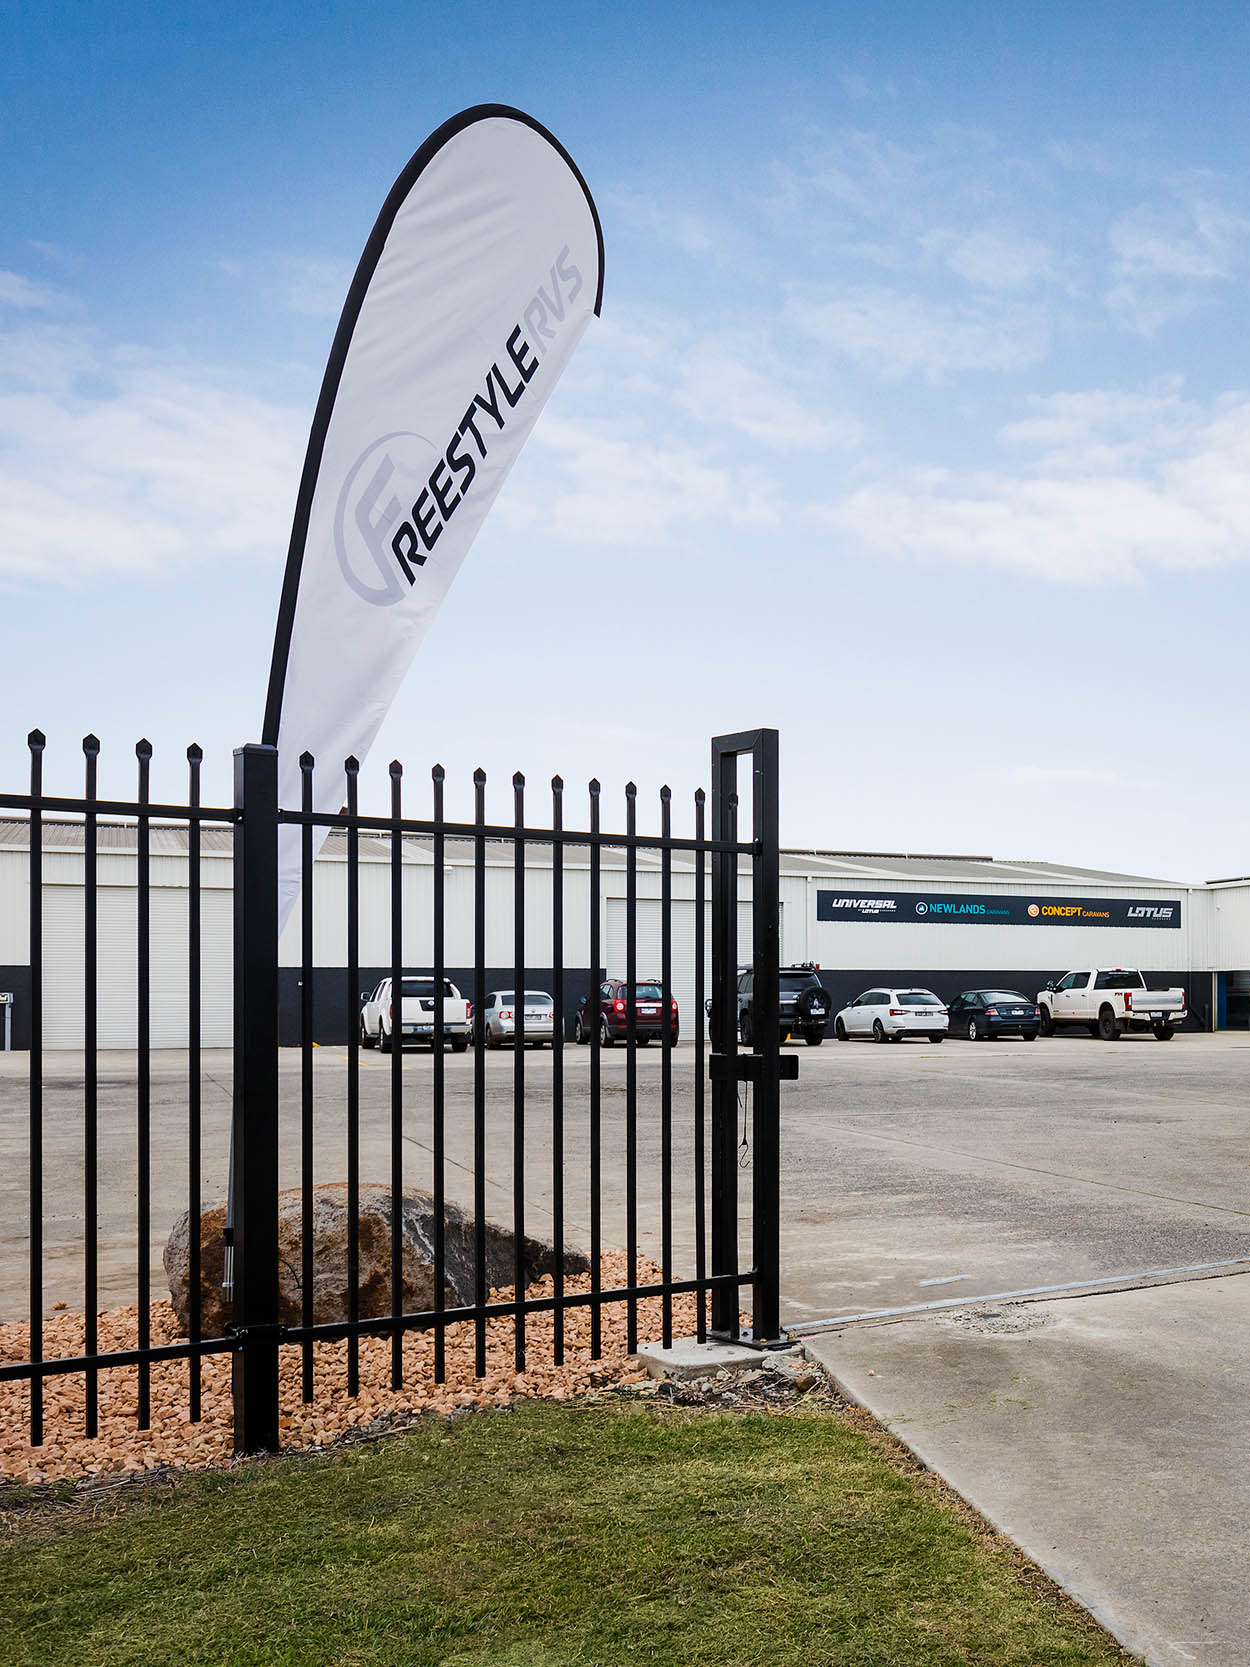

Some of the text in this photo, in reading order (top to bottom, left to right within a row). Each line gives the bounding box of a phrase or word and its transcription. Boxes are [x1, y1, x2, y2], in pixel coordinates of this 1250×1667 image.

[832, 899, 897, 909] UNIVERSAL
[929, 904, 986, 914] NEWLANDS
[1041, 906, 1083, 917] CONCEPT
[1127, 906, 1173, 918] LOTUS
